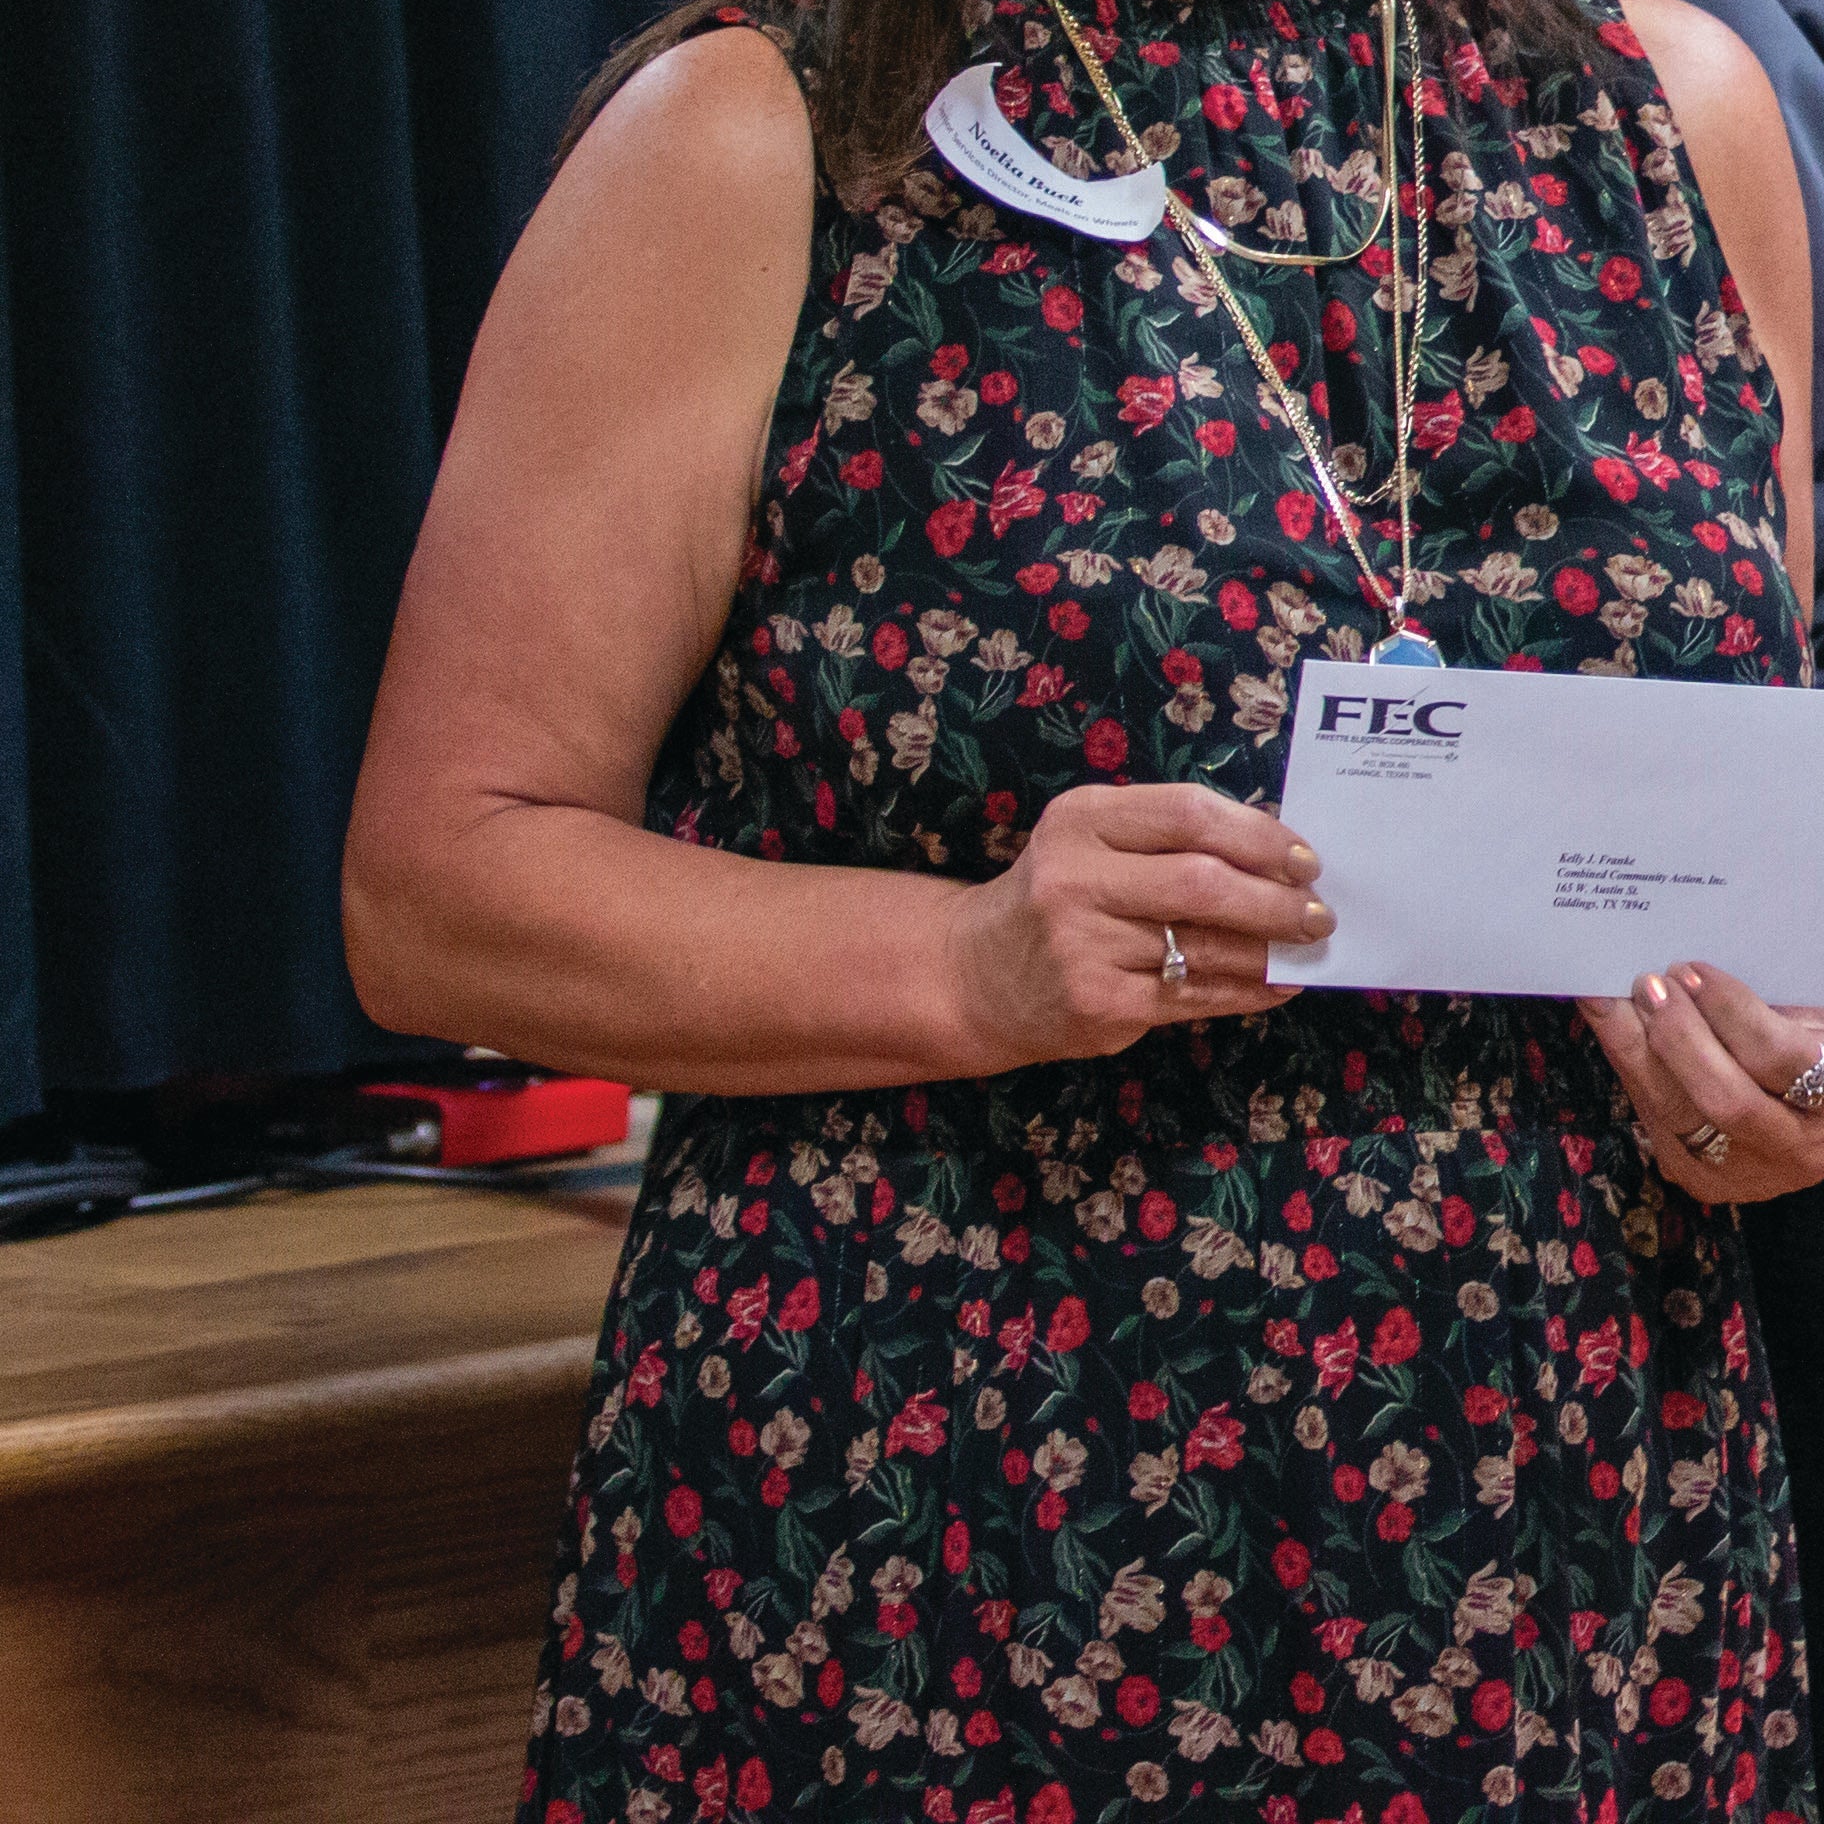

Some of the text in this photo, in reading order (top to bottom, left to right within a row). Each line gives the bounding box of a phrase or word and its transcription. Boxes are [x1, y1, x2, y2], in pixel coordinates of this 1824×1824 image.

[968, 121, 1086, 208] Noelia Buck
[1318, 694, 1468, 738] FEC
[1559, 852, 1584, 866] Kelly
[1557, 867, 1607, 880] Combined
[1609, 869, 1667, 884] Community
[1591, 883, 1624, 896] Austin
[1553, 896, 1599, 910] Giddings,
[1602, 898, 1618, 910] TX
